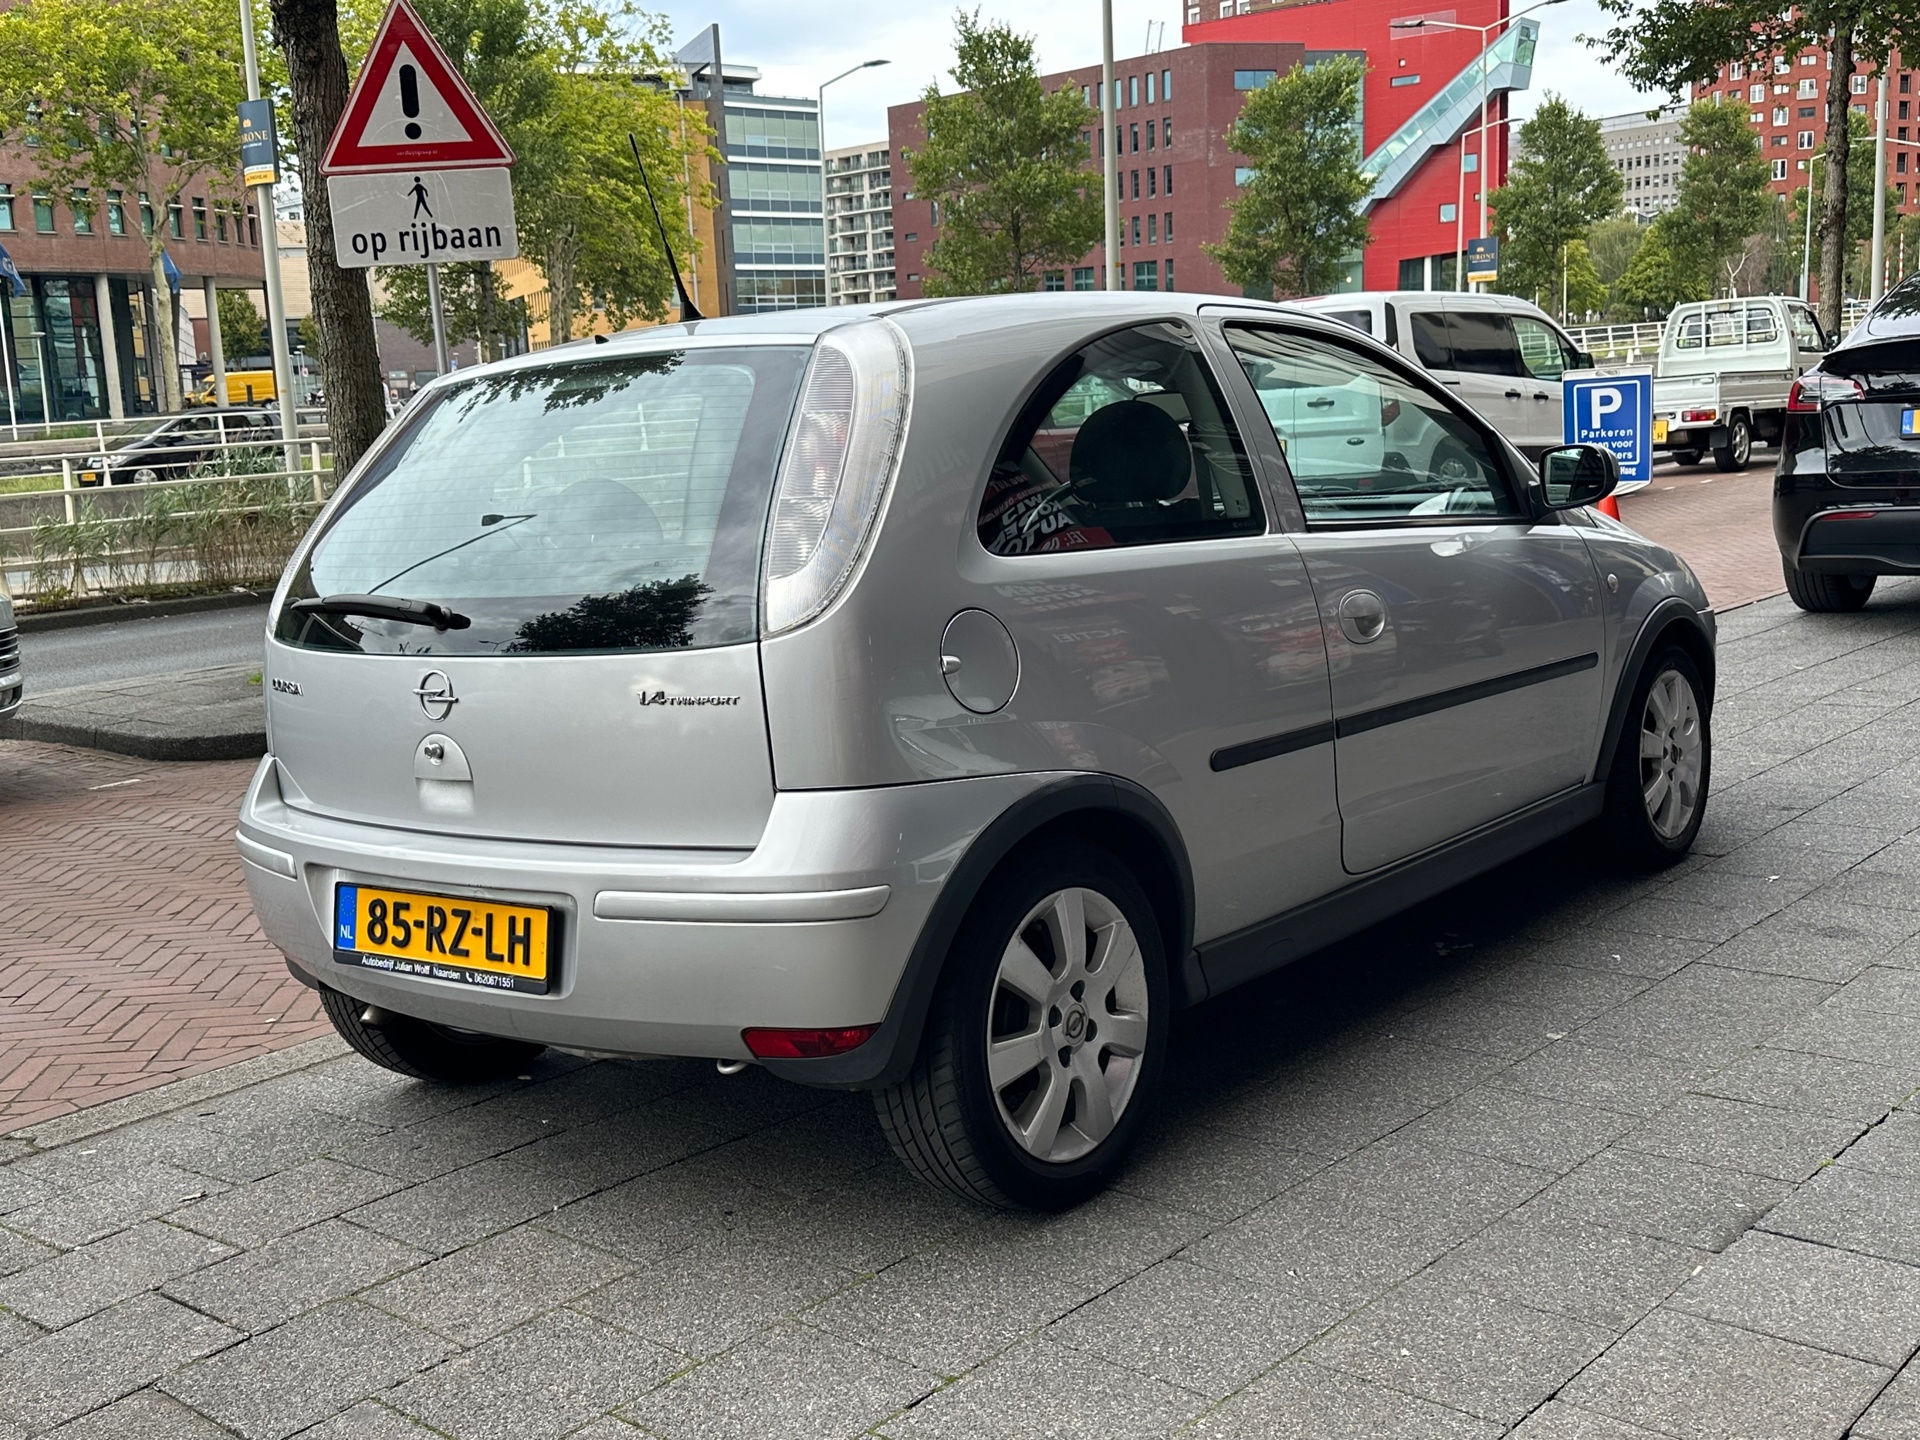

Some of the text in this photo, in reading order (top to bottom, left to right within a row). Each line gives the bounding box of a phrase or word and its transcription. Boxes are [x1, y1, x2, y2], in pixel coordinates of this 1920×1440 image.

[352, 222, 502, 261] op rijbaan
[1591, 387, 1622, 430] P
[1581, 428, 1633, 439] Parkeren
[1611, 440, 1634, 448] voor
[1620, 466, 1637, 476] Haag
[667, 696, 741, 706] TWINPORT
[340, 924, 353, 939] NL
[367, 898, 531, 966] 85-RZ-LH
[361, 955, 514, 989] Autobedrijf Julian Wolff Naarden 0620671551
